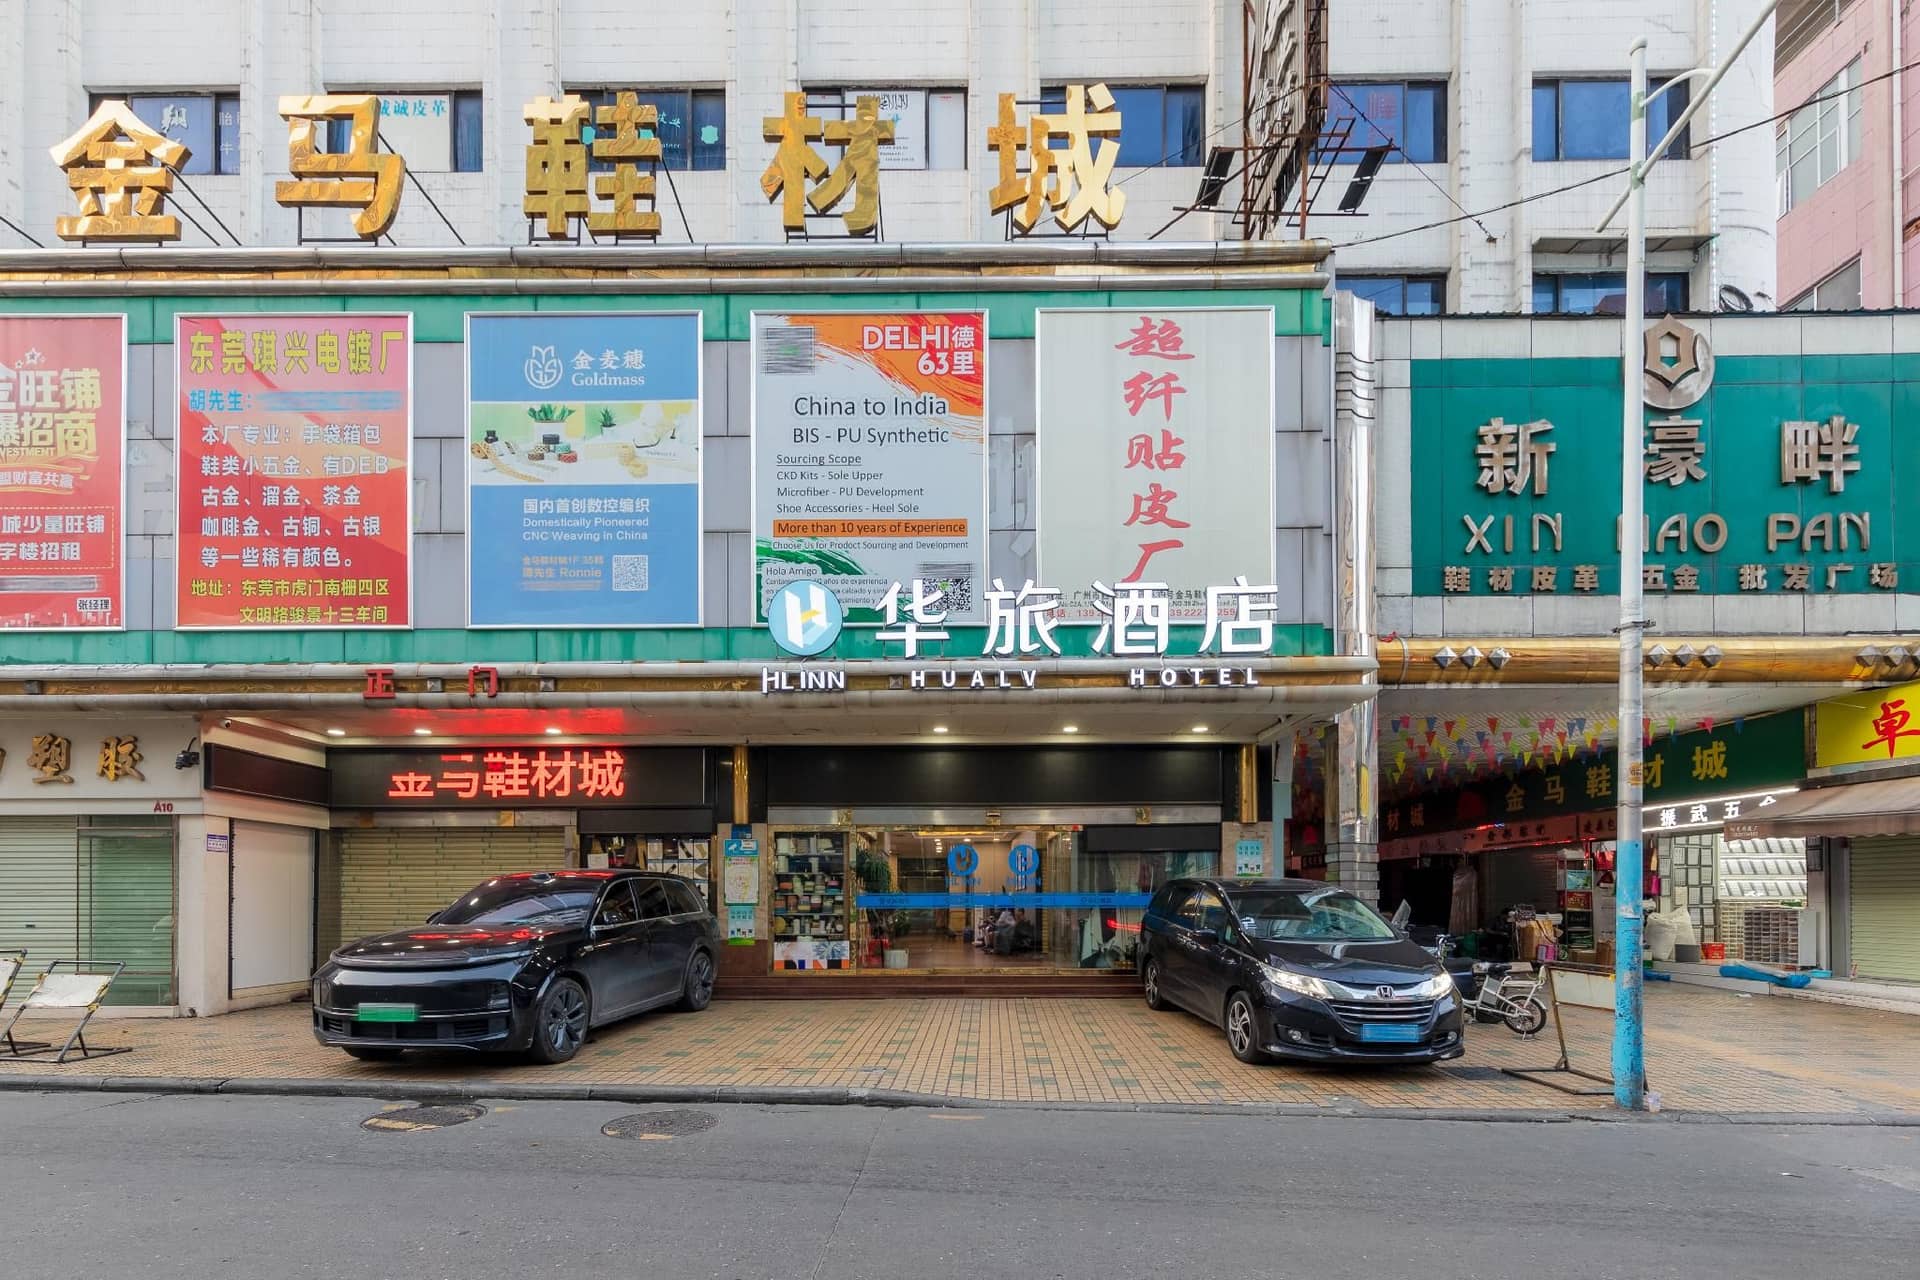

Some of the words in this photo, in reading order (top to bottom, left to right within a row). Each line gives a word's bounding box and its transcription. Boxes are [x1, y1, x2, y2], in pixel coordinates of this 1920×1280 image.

[49, 86, 1126, 243] 金马鞋材城
[864, 326, 949, 349] DELHI
[571, 349, 646, 370] 金麦穗
[572, 372, 645, 387] Goldmass
[795, 397, 855, 415] China
[864, 399, 886, 415] to
[895, 396, 946, 415] India
[793, 428, 820, 443] BIS
[837, 428, 861, 443] PU
[867, 427, 949, 447] Synthetic
[1115, 317, 1195, 583] 超纤贴皮厂
[777, 454, 825, 465] Sourcing
[829, 454, 862, 465] Scope
[777, 471, 798, 480] CKD
[800, 471, 818, 480] Kits
[828, 470, 849, 480] Sole
[852, 471, 883, 482] Upper
[777, 487, 829, 497] Microfiber
[839, 487, 853, 496] PU
[856, 487, 924, 498] Development
[523, 498, 650, 514] 国内首创数控编织
[777, 503, 802, 513] Shoe
[805, 503, 863, 513] Accessories
[872, 503, 895, 513] Heel
[898, 503, 919, 513] Sole
[523, 517, 592, 529] Domestically
[595, 517, 649, 527] Pioneered
[778, 522, 808, 533] More
[812, 522, 836, 533] than
[842, 522, 854, 533] 10
[858, 523, 887, 535] years
[890, 521, 902, 533] of
[905, 521, 966, 534] Experience
[523, 531, 549, 541] CNC
[552, 531, 600, 543] Weaving
[603, 531, 613, 540] in
[617, 531, 648, 541] China
[1463, 513, 1562, 553] XIN
[1768, 512, 1871, 553] PAN
[773, 541, 802, 550] Choose
[805, 541, 814, 549] Us
[816, 541, 828, 549] for
[830, 541, 860, 549] Product
[863, 540, 897, 551] Sourcing
[900, 540, 914, 549] and
[917, 540, 968, 551] Development
[766, 567, 787, 575] Hola
[789, 568, 818, 577] Amigo
[78, 599, 110, 611] 张经理
[875, 577, 1278, 655] 华旅酒店
[363, 668, 499, 699] 正门
[801, 670, 845, 688] INN
[911, 669, 1037, 688] HUALV
[1130, 666, 1258, 685] HOTEL
[154, 803, 174, 813] A10
